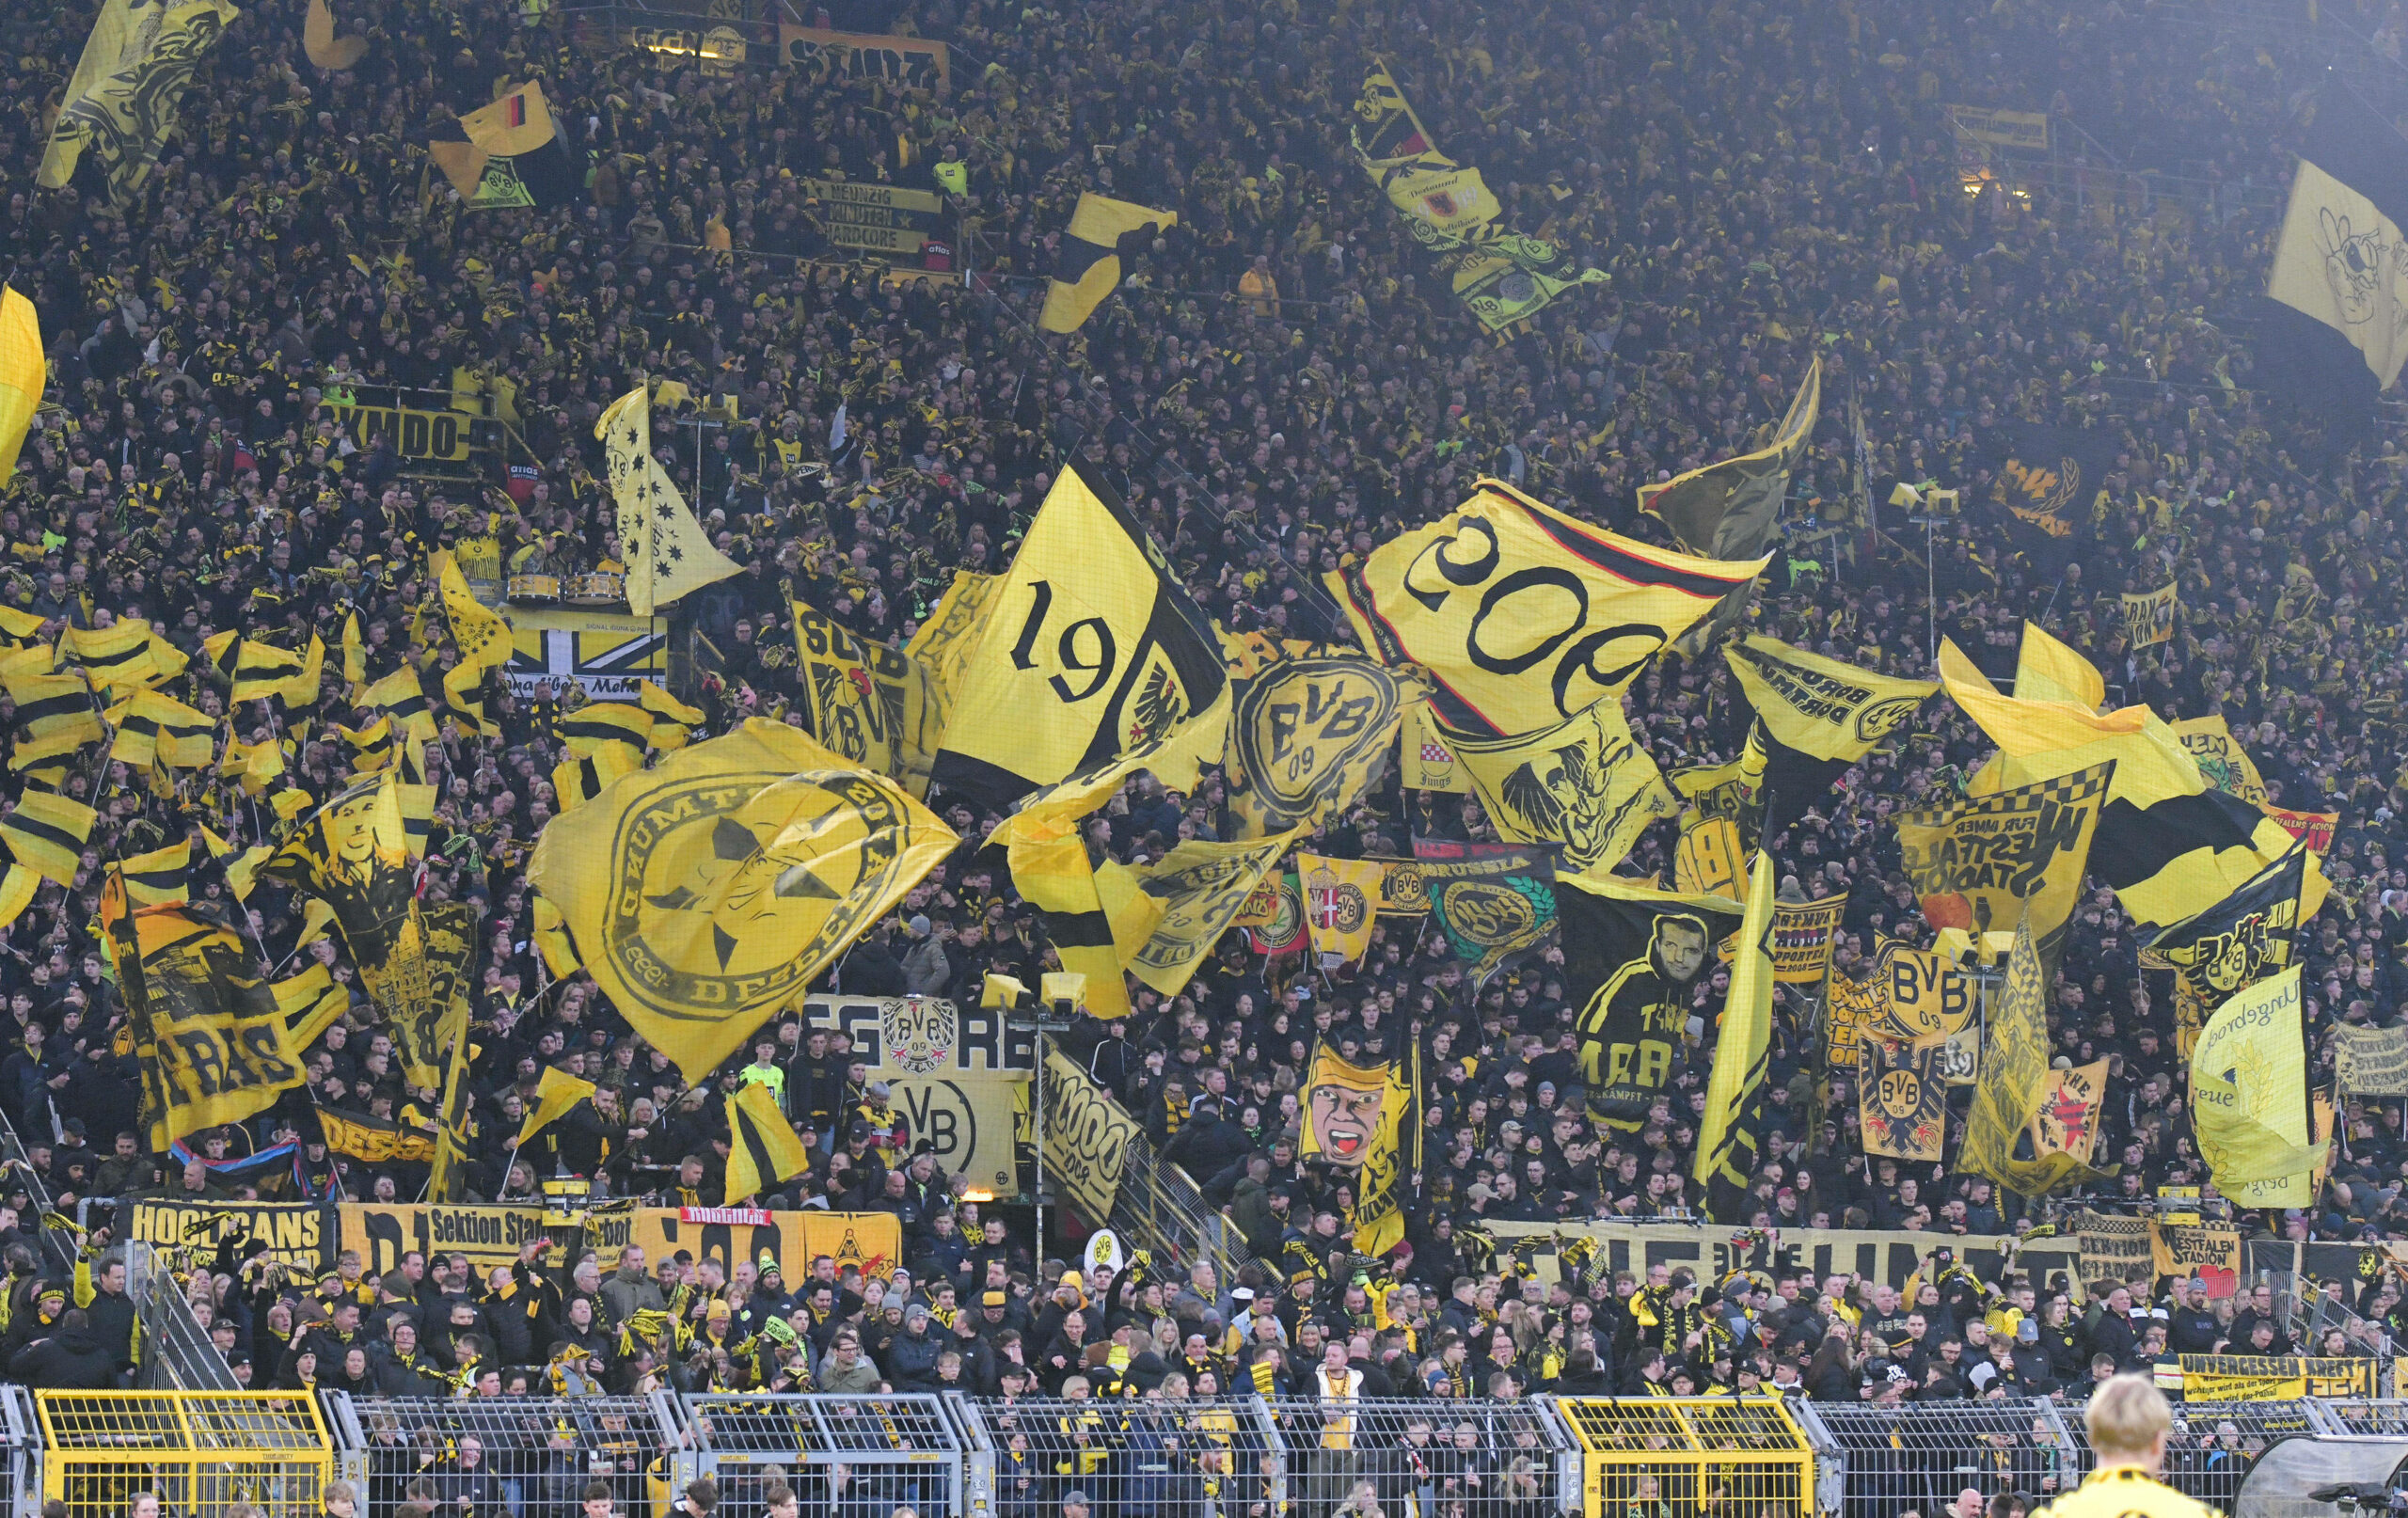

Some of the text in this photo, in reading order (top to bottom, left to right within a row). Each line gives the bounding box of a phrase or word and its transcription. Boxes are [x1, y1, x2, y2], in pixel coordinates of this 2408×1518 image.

[831, 184, 892, 205] NEUNZIG
[829, 203, 893, 226] MINUTEN
[1271, 681, 1374, 768] BVB
[1289, 750, 1315, 783] 09
[1419, 772, 1451, 789] Jungs
[1398, 875, 1419, 893] BVB
[1786, 962, 1807, 972] 2008
[1893, 953, 1968, 1015] BVB
[1918, 1010, 1941, 1030] 09
[911, 1043, 927, 1052] 09
[1882, 1073, 1919, 1106] BVB
[1893, 1104, 1905, 1115] 09
[430, 1209, 501, 1244] Sektion
[1096, 1236, 1111, 1258] BVB
[2158, 1225, 2235, 1254] WESTFALEN
[2173, 1247, 2226, 1266] STADION
[2182, 1354, 2300, 1376] UNVERGESSEN
[2217, 1384, 2233, 1392] wird
[2235, 1382, 2244, 1390] als
[2246, 1380, 2258, 1388] der
